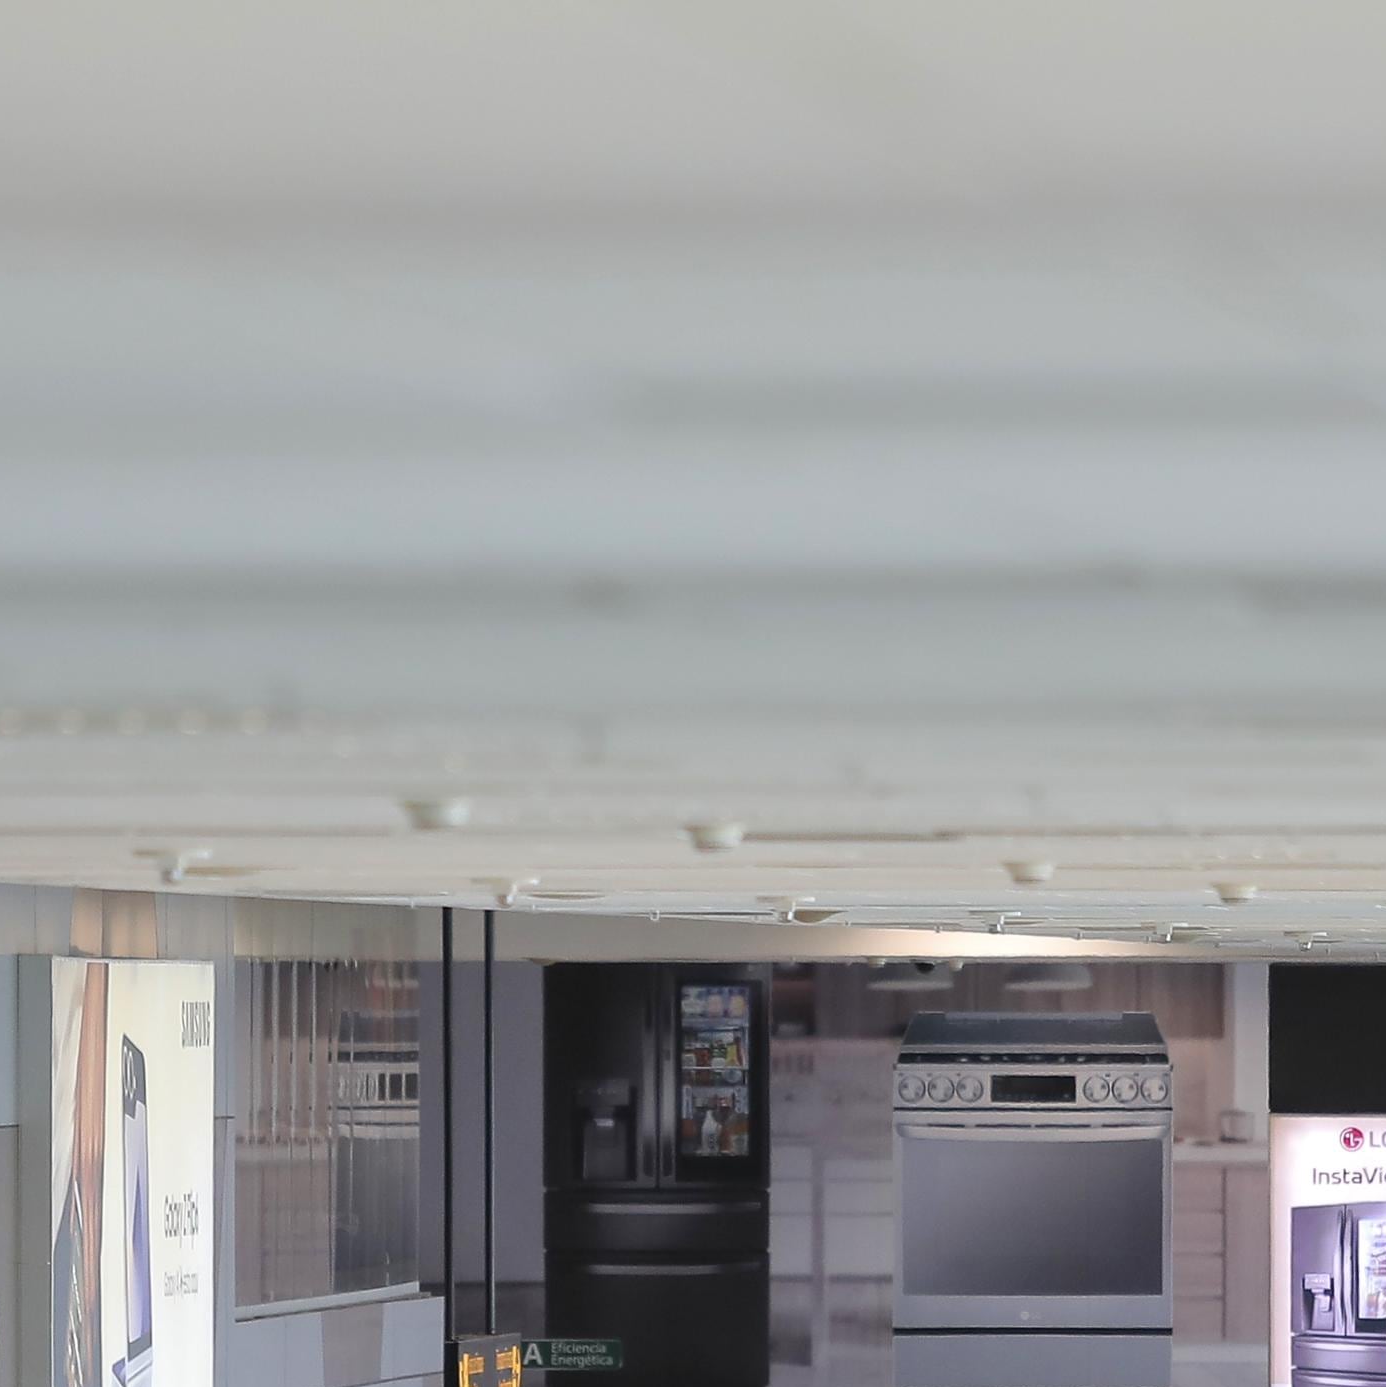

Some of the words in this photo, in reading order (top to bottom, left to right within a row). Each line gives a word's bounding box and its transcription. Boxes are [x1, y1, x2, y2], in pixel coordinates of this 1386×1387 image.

[181, 1000, 211, 1049] SAMSUNG
[523, 1343, 543, 1366] A
[551, 1343, 606, 1354] Eficiencia
